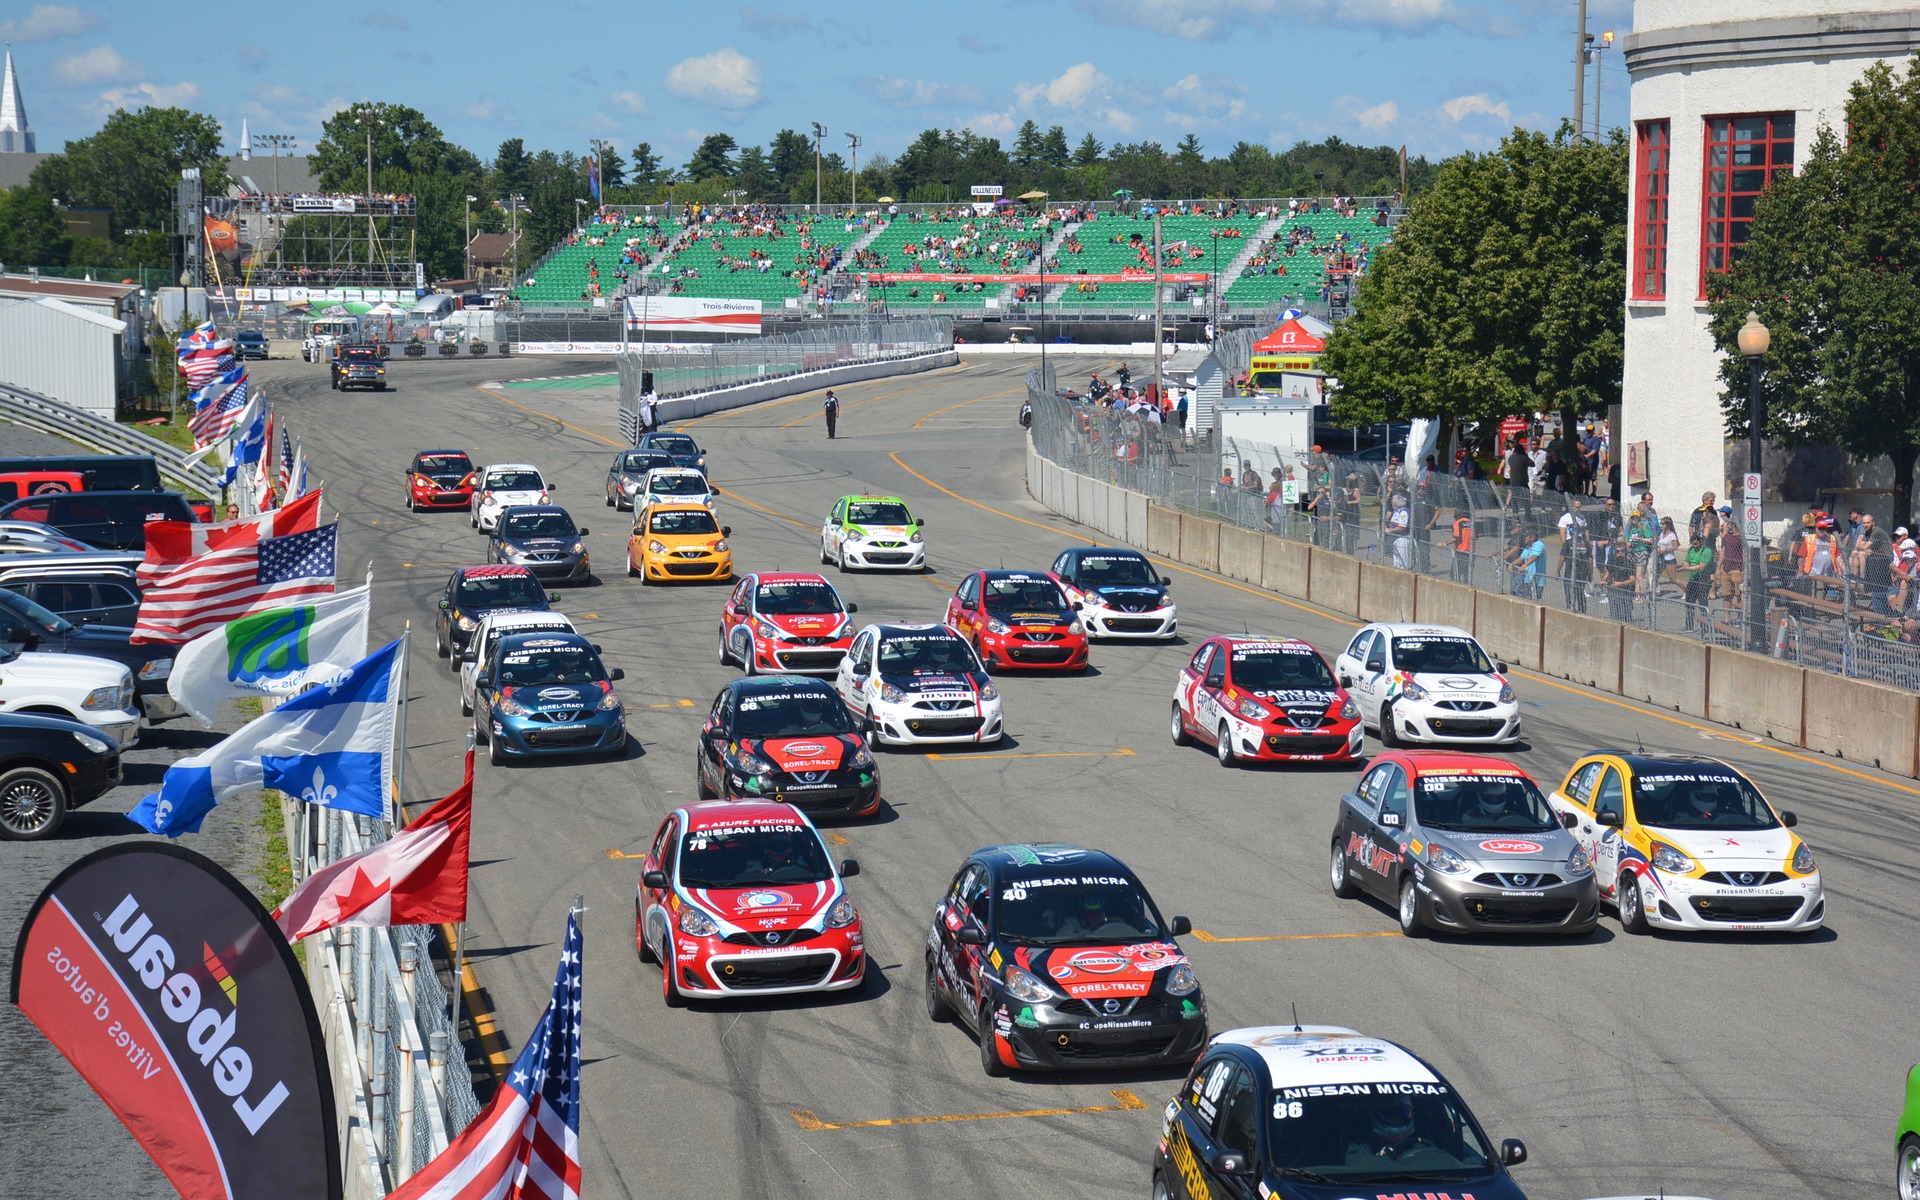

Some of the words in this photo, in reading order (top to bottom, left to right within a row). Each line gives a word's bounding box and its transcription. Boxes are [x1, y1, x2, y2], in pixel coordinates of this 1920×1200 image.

[702, 302, 755, 311] Trois-Rivières
[510, 648, 551, 656] NISSAN
[881, 644, 891, 655] 7
[745, 694, 790, 703] NISSAN
[740, 703, 758, 712] 96
[784, 760, 836, 768] SOREL-TRACY
[1423, 776, 1479, 784] NISSAN
[1482, 776, 1523, 784] MICRA
[1639, 775, 1695, 783] NISSAN
[1698, 775, 1739, 784] MICRA
[1424, 783, 1444, 792] 00
[711, 820, 750, 828] AZURE
[1383, 814, 1399, 825] 00
[697, 827, 756, 838] NISSAN
[760, 825, 802, 833] MICRA
[689, 839, 707, 851] 78
[1489, 842, 1537, 850] Lloyds
[1012, 877, 1078, 890] NISSAN
[1082, 877, 1129, 886] MICRA
[1003, 888, 1027, 901] 40
[1716, 888, 1784, 896] #NissanMicraCup
[1072, 983, 1146, 994] SOREL-TRACY
[1316, 1056, 1369, 1064] Castrol
[1205, 1062, 1230, 1103] 86
[1283, 1084, 1371, 1100] NISSAN
[1376, 1084, 1440, 1096] MICRA
[1273, 1102, 1303, 1120] 86
